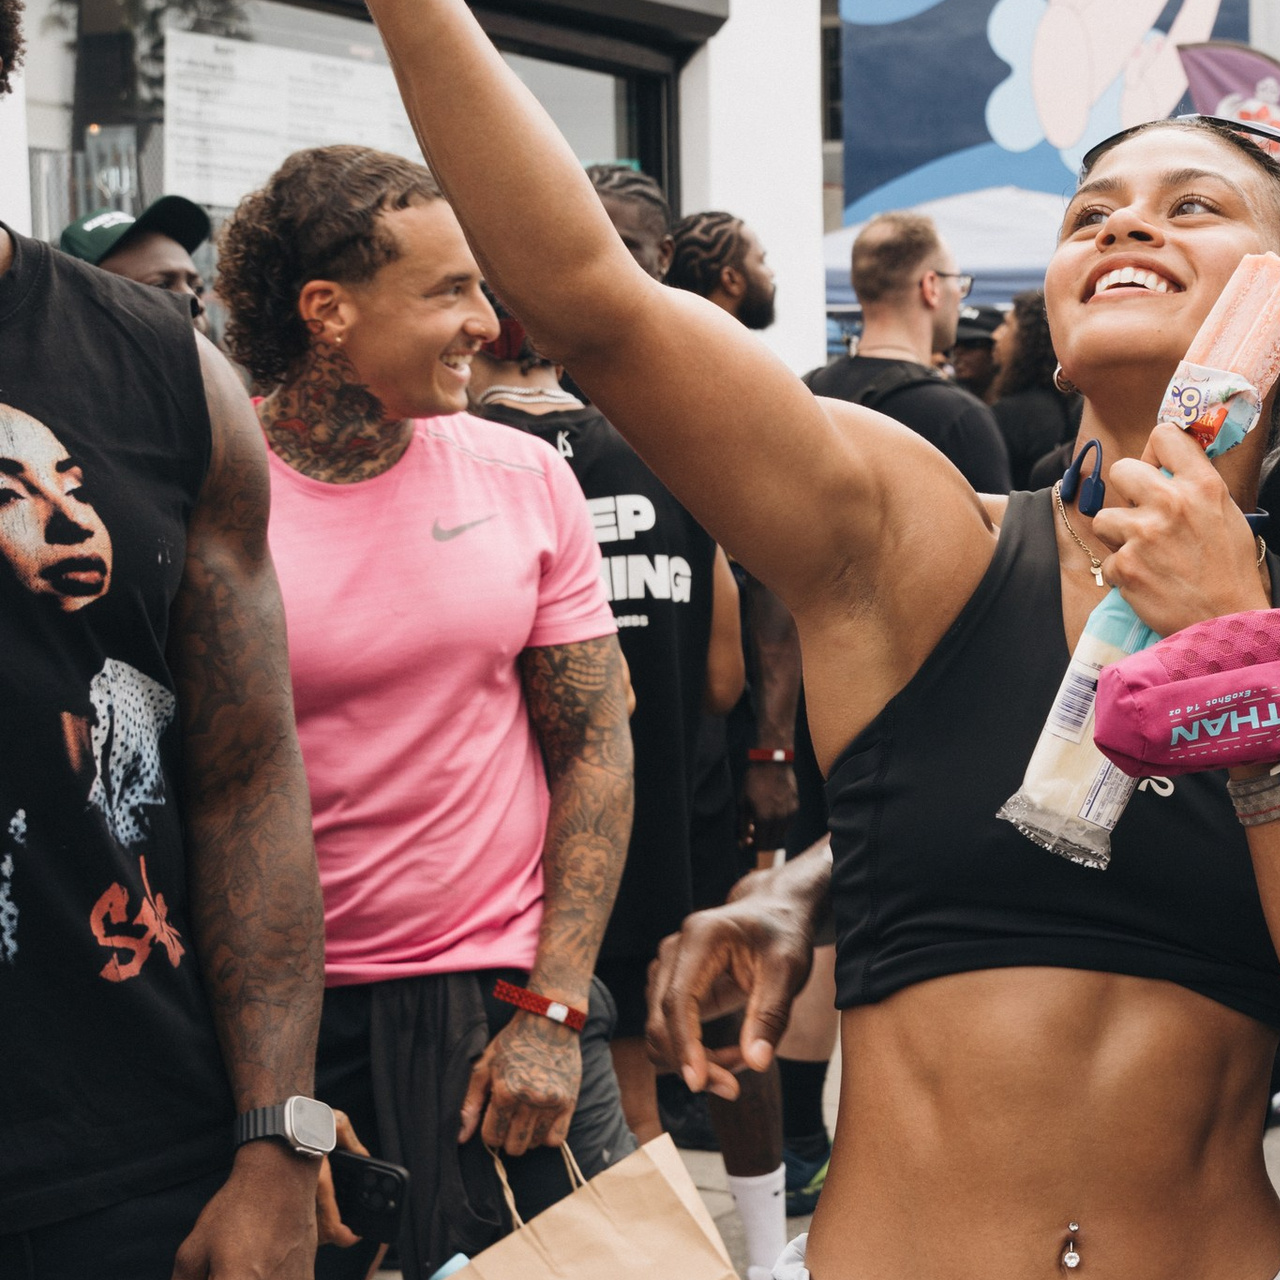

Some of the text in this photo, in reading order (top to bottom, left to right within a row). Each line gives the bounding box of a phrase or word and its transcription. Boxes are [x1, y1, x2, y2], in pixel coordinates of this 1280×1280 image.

[1168, 689, 1252, 717] ExoShot 14 oz
